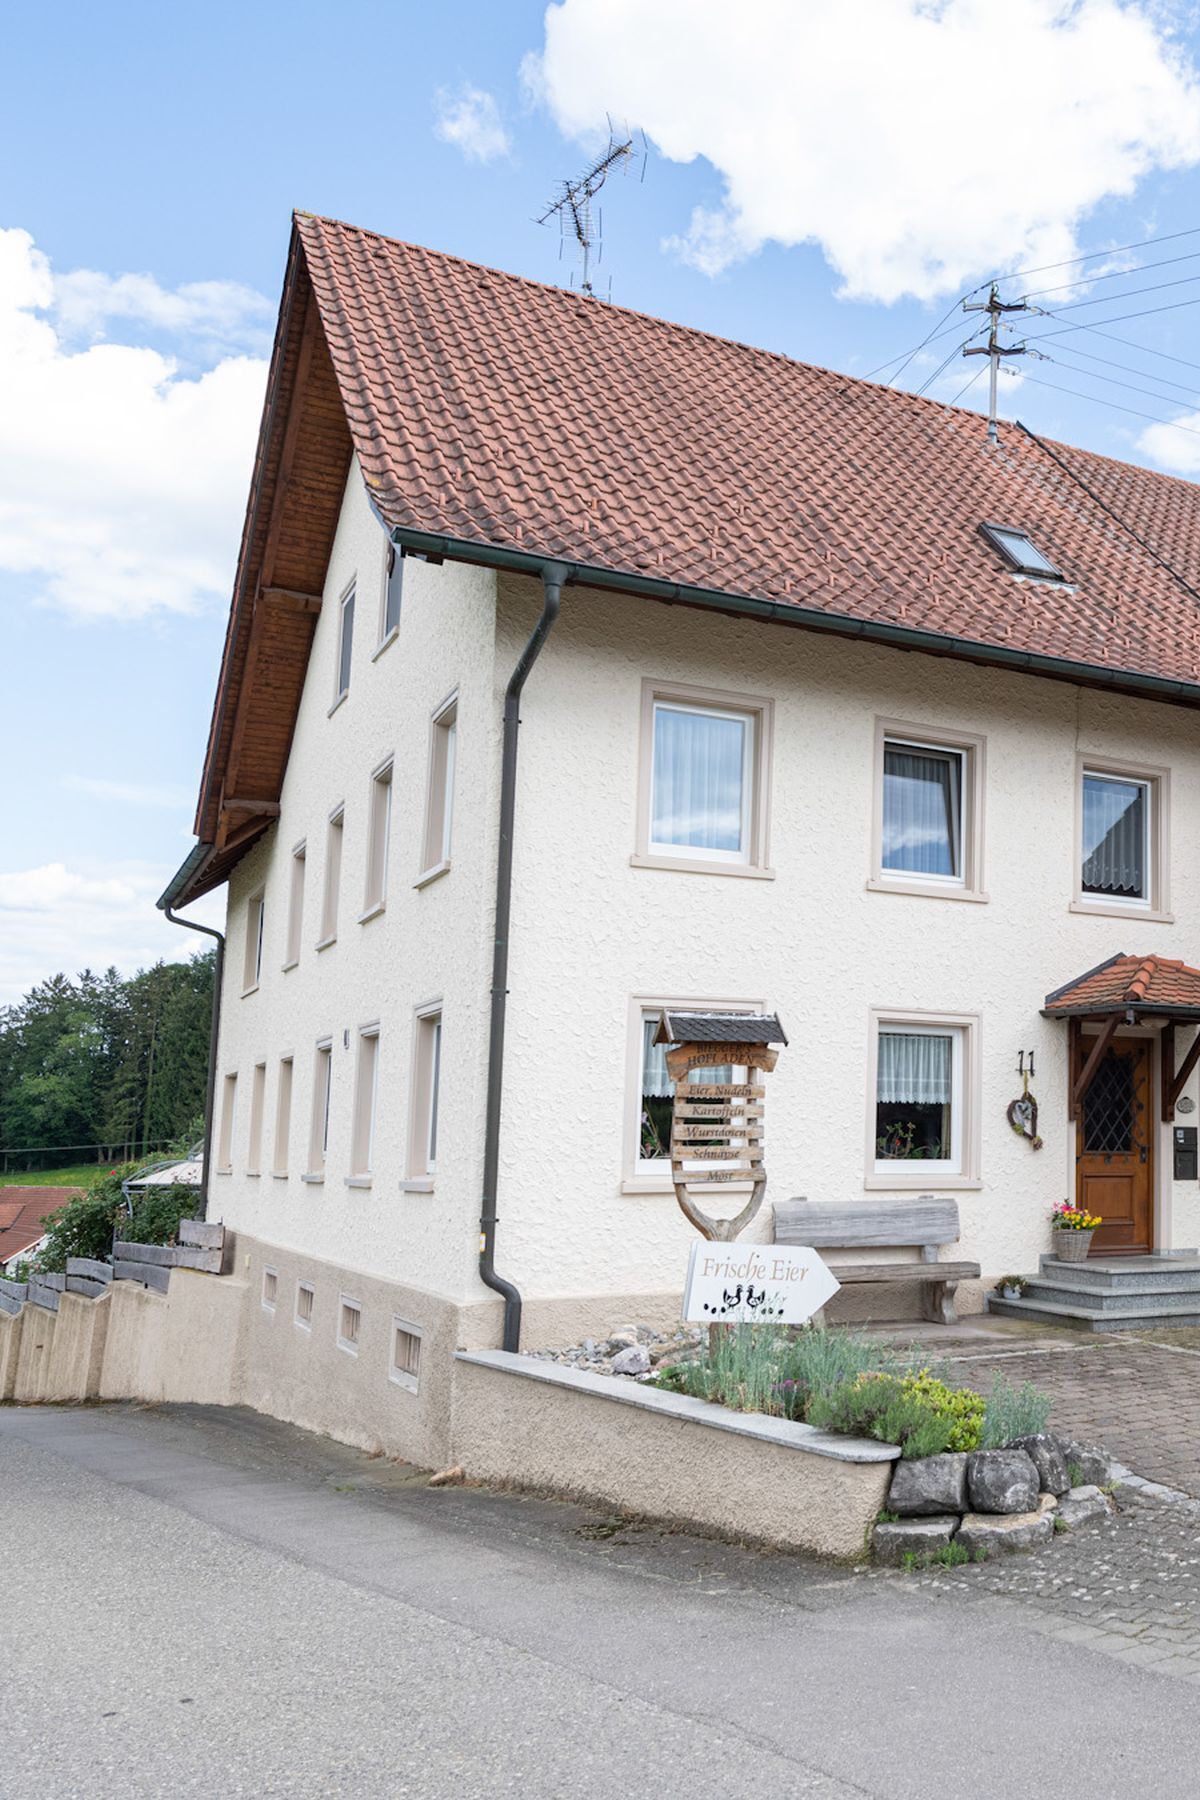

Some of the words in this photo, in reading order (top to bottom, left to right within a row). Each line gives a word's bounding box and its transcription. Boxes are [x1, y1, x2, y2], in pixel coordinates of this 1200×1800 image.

[687, 1053, 753, 1066] HOFLADEN
[1017, 1050, 1035, 1077] 11
[715, 1084, 752, 1096] Nudeln
[692, 1105, 745, 1118] Kartoffeln
[687, 1126, 747, 1138] Wurstdosen
[705, 1170, 734, 1181] Most
[701, 1251, 766, 1283] Frische
[769, 1259, 809, 1282] Eier
